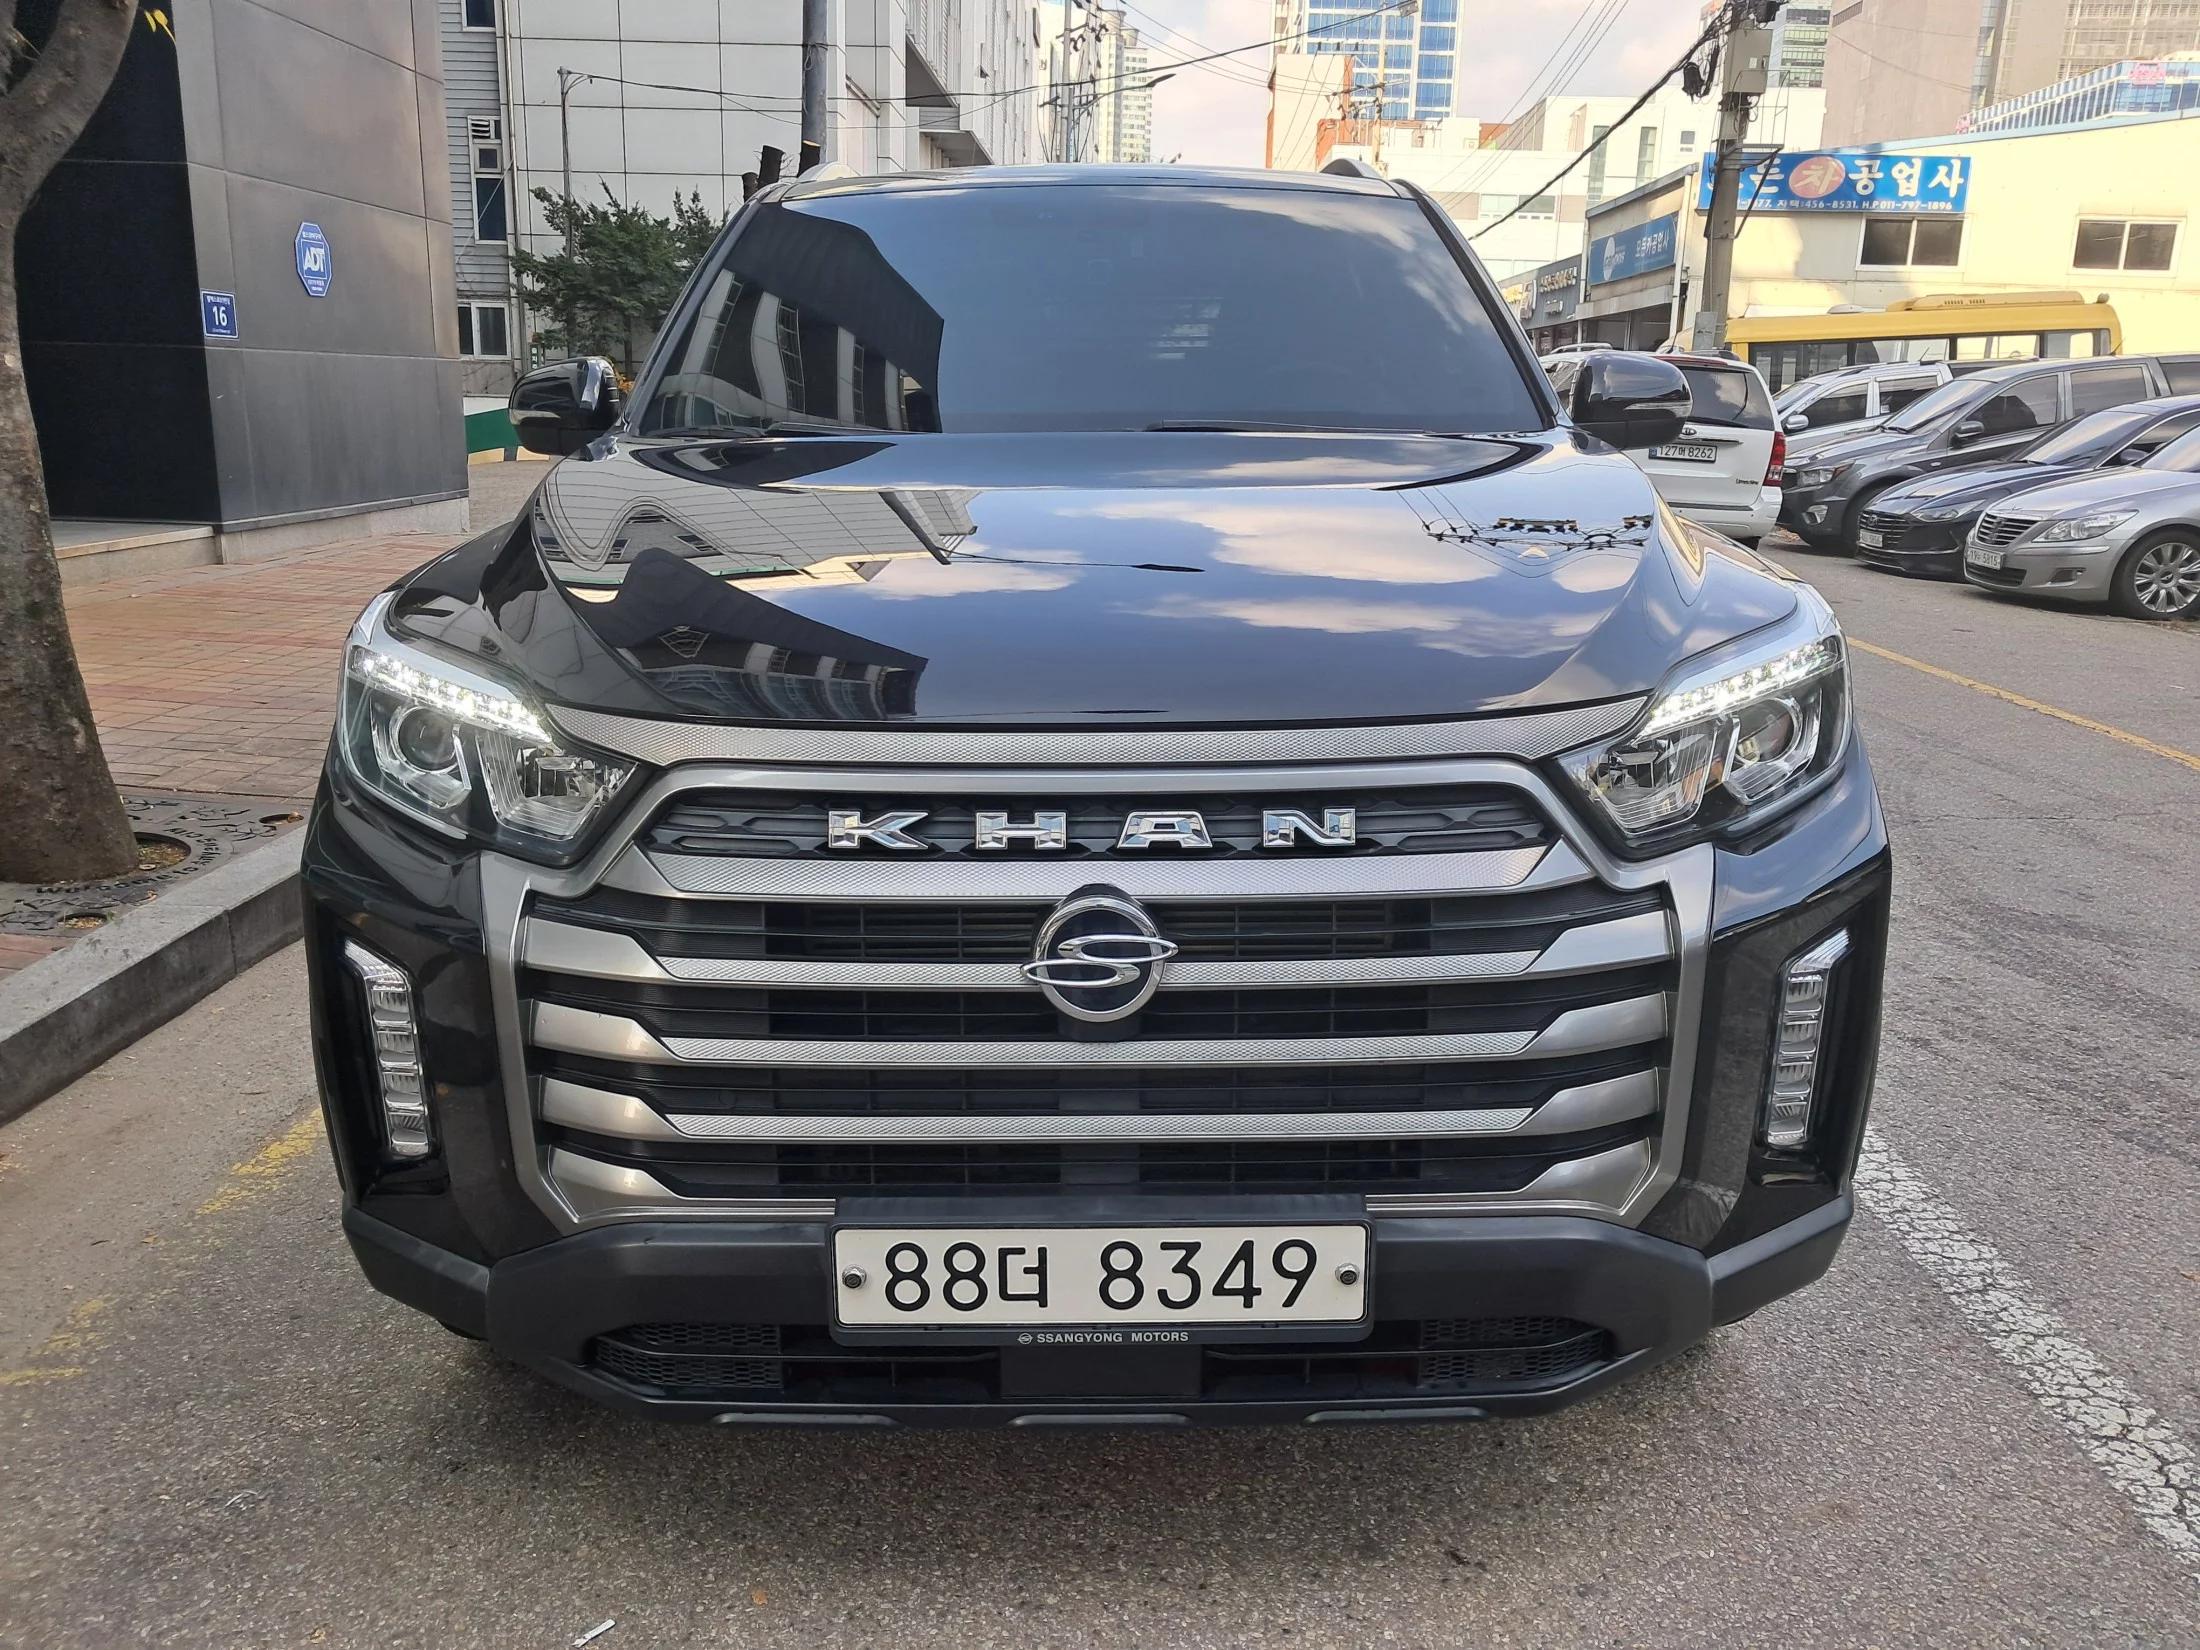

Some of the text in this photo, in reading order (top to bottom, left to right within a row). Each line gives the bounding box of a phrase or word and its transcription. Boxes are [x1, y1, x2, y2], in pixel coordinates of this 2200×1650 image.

[304, 247, 325, 273] ADT
[212, 305, 228, 327] 16
[1687, 446, 1714, 459] 8262
[827, 807, 1357, 851] KHAN
[884, 1238, 1318, 1312] 88더 8349
[1036, 1331, 1190, 1344] SSANGYONG MOTORS
